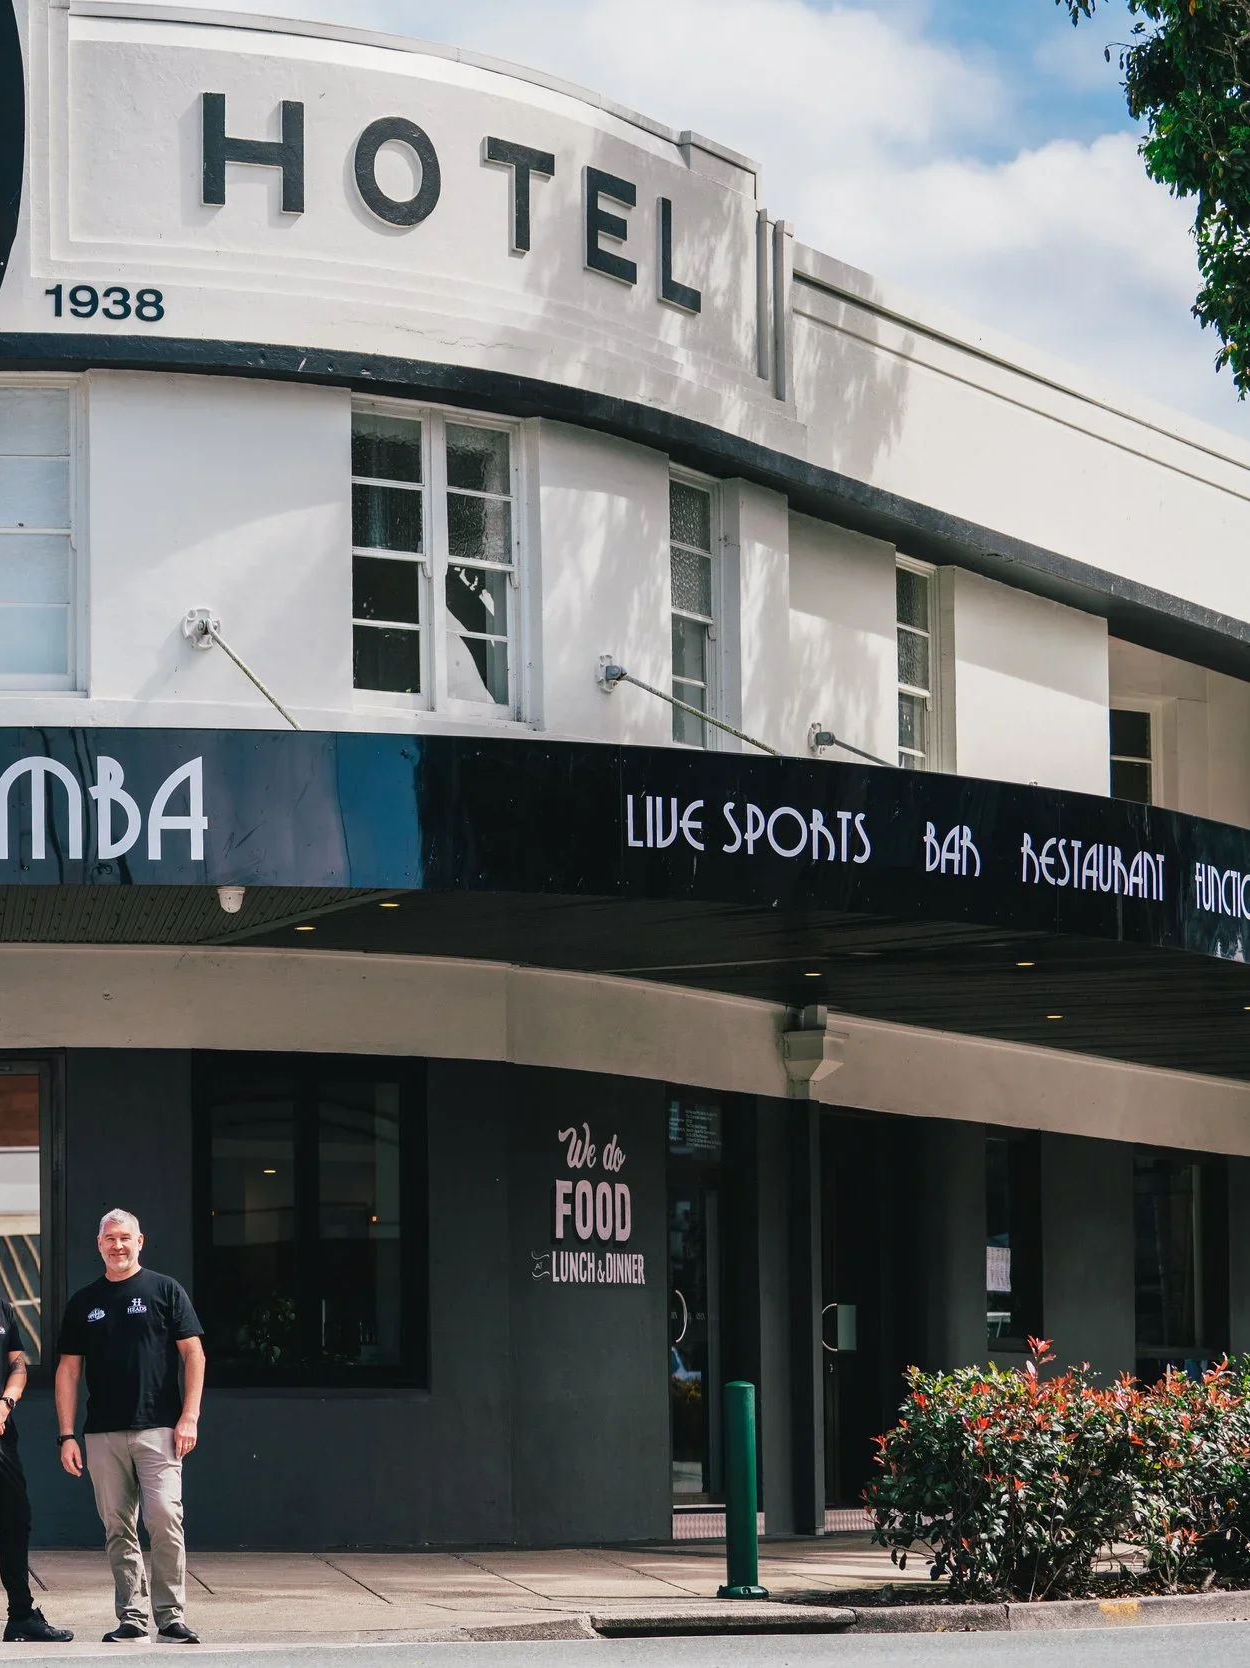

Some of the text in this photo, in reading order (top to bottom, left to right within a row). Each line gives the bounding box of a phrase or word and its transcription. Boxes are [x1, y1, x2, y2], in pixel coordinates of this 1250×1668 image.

[202, 92, 702, 314] HOTEL
[44, 284, 166, 322] 1938
[626, 793, 705, 852] LIVE
[722, 802, 871, 865] SPORTS
[923, 821, 981, 878] BAR
[1021, 832, 1165, 902] RESTAURANT
[558, 1122, 626, 1173] We do
[555, 1179, 632, 1242] FOOD
[552, 1250, 596, 1283] LUNCH
[605, 1252, 646, 1285] DINNER
